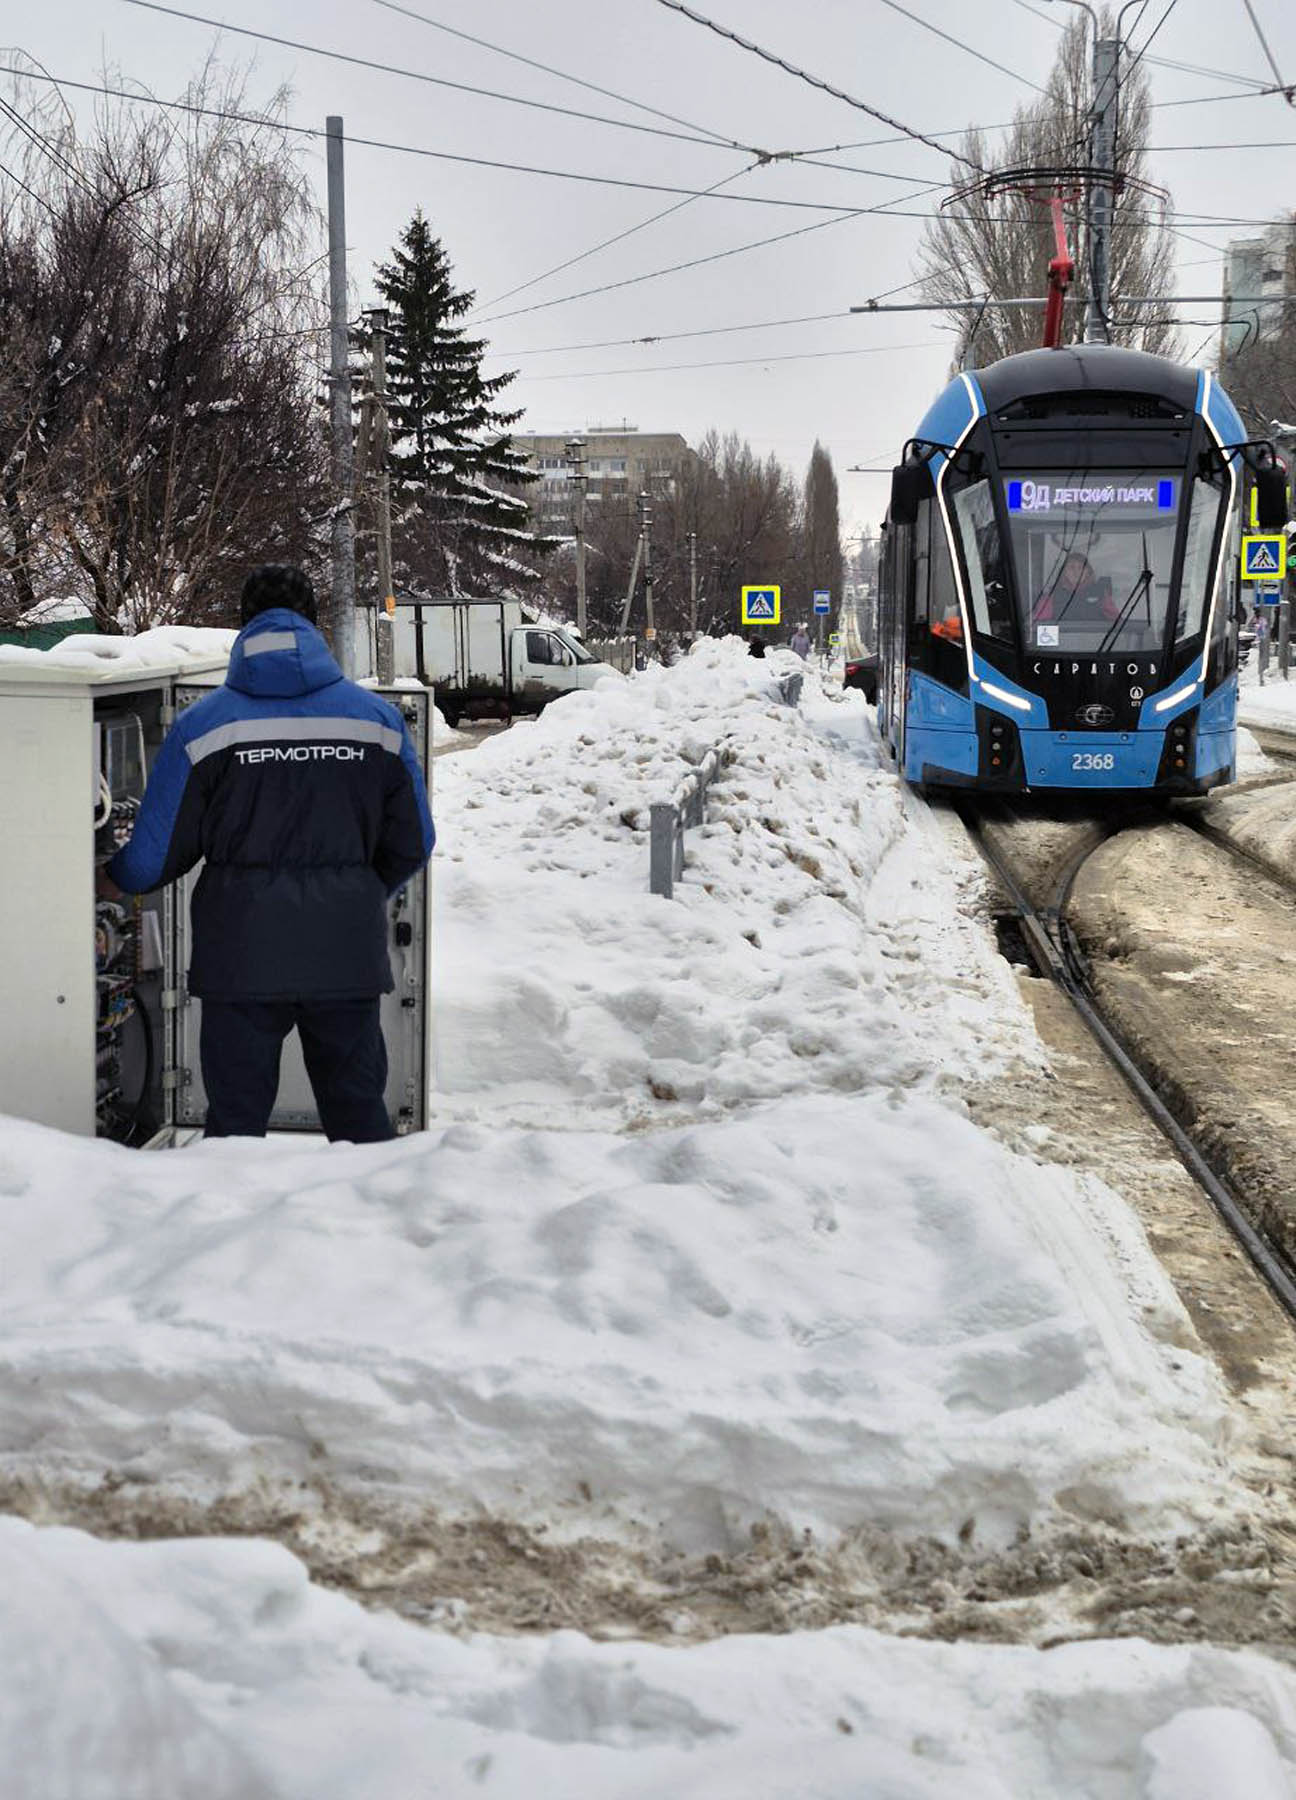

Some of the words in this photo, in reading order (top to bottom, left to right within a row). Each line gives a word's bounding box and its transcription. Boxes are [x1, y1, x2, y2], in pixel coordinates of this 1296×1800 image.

[1054, 485, 1116, 505] ДЕТСКИЙ
[1117, 487, 1154, 502] ПАРК
[1033, 662, 1157, 674] САРАТОВ
[234, 745, 365, 765] ТЕРМОТРОН
[1071, 753, 1114, 770] 2368
